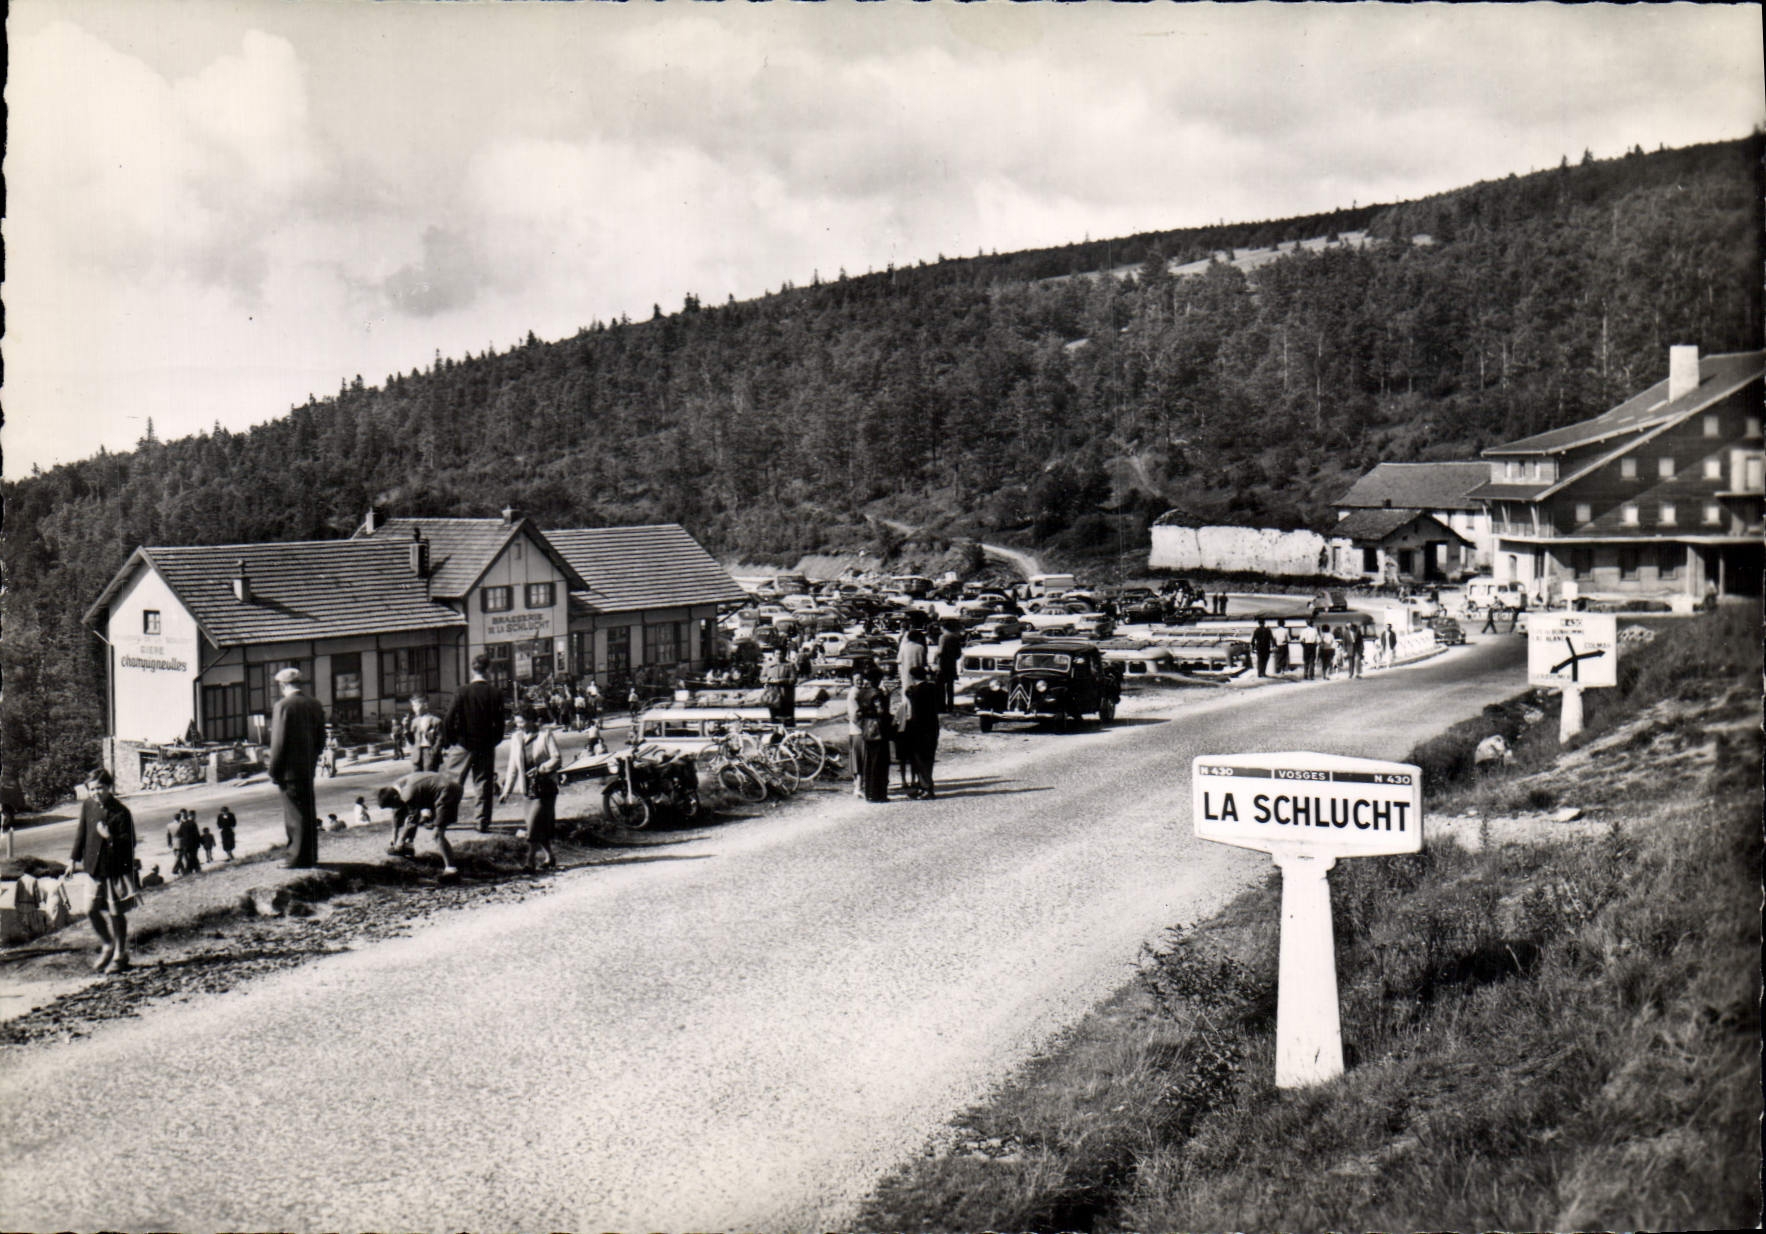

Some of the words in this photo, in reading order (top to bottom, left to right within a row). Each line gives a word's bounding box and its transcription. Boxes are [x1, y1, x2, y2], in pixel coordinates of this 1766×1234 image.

[1200, 766, 1209, 776] N
[1211, 767, 1234, 777] 430
[1278, 769, 1326, 781] VOSGES
[1374, 775, 1383, 784] N
[1386, 775, 1411, 785] 430
[1204, 792, 1239, 822] LA
[1254, 794, 1411, 832] SCHLUCHT
